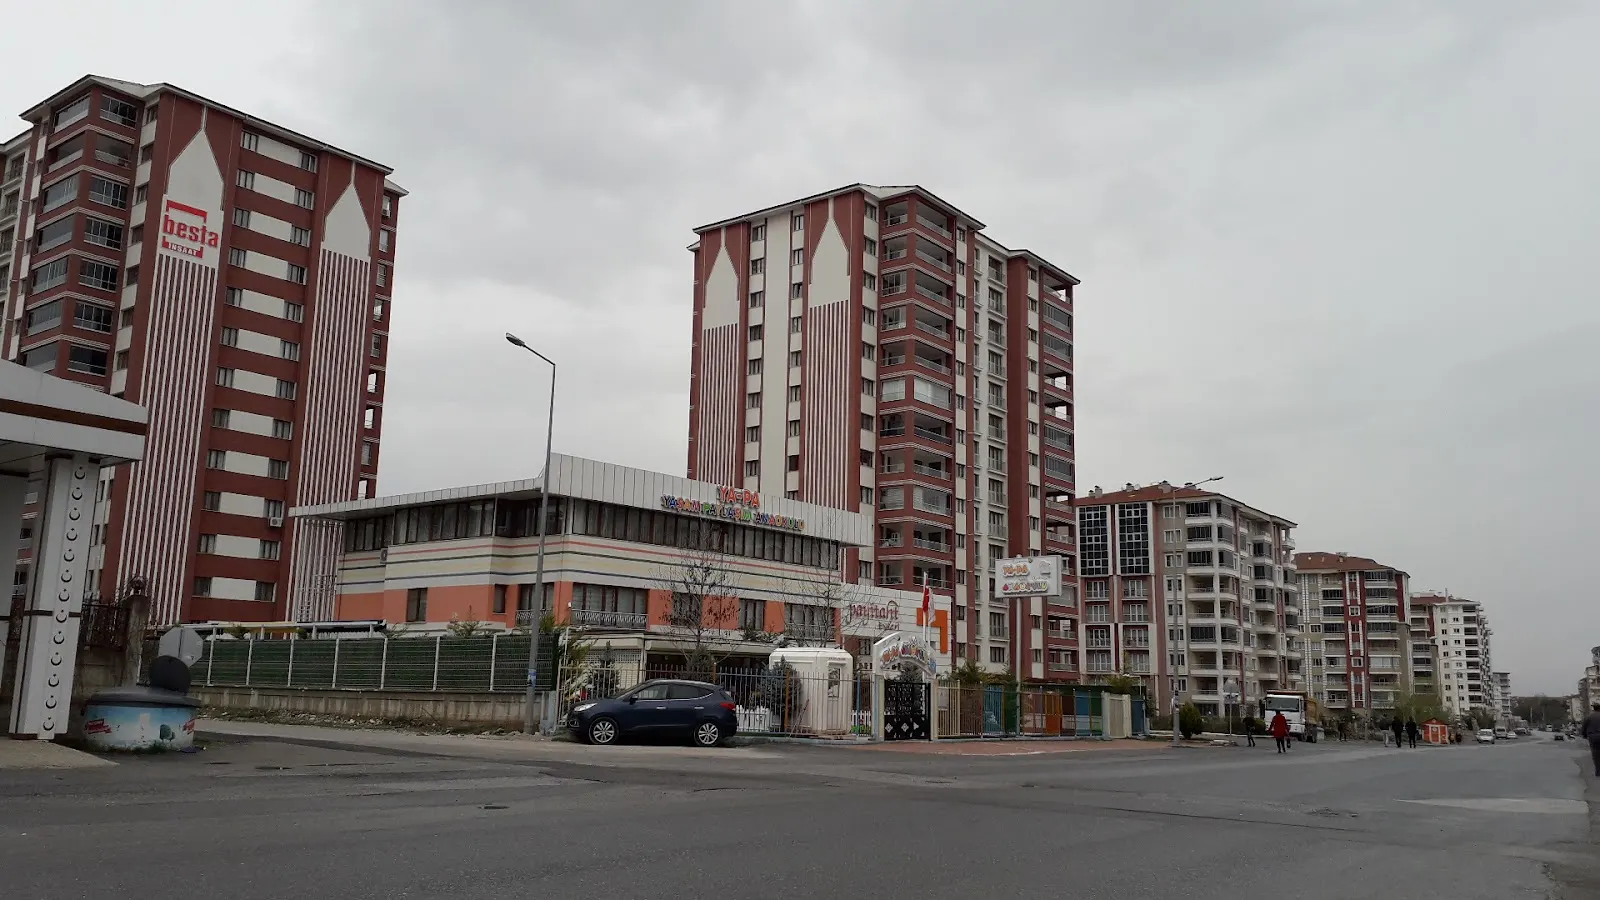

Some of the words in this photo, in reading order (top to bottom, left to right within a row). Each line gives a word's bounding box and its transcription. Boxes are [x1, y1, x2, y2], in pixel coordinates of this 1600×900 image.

[163, 214, 219, 248] besta
[719, 486, 760, 508] YA-PA
[755, 512, 805, 531] ANAOKULU
